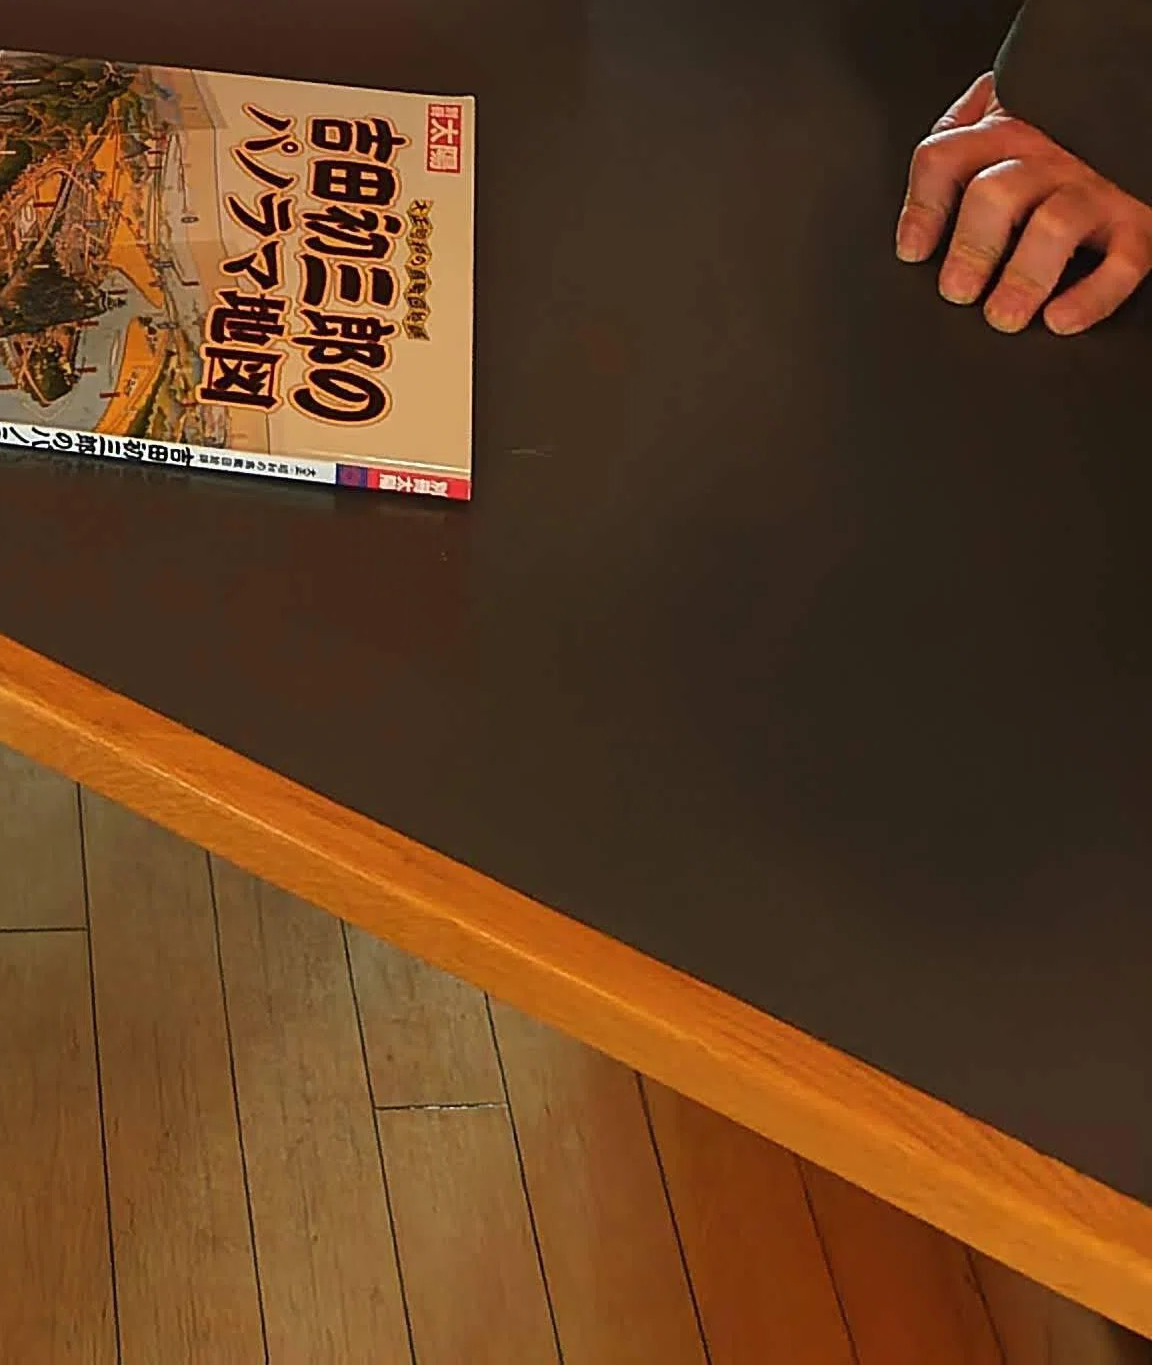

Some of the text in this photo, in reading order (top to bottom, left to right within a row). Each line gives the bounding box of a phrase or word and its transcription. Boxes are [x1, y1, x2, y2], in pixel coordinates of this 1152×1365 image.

[199, 103, 300, 410] パノラマ地図
[290, 115, 408, 423] 吉田初三郎の
